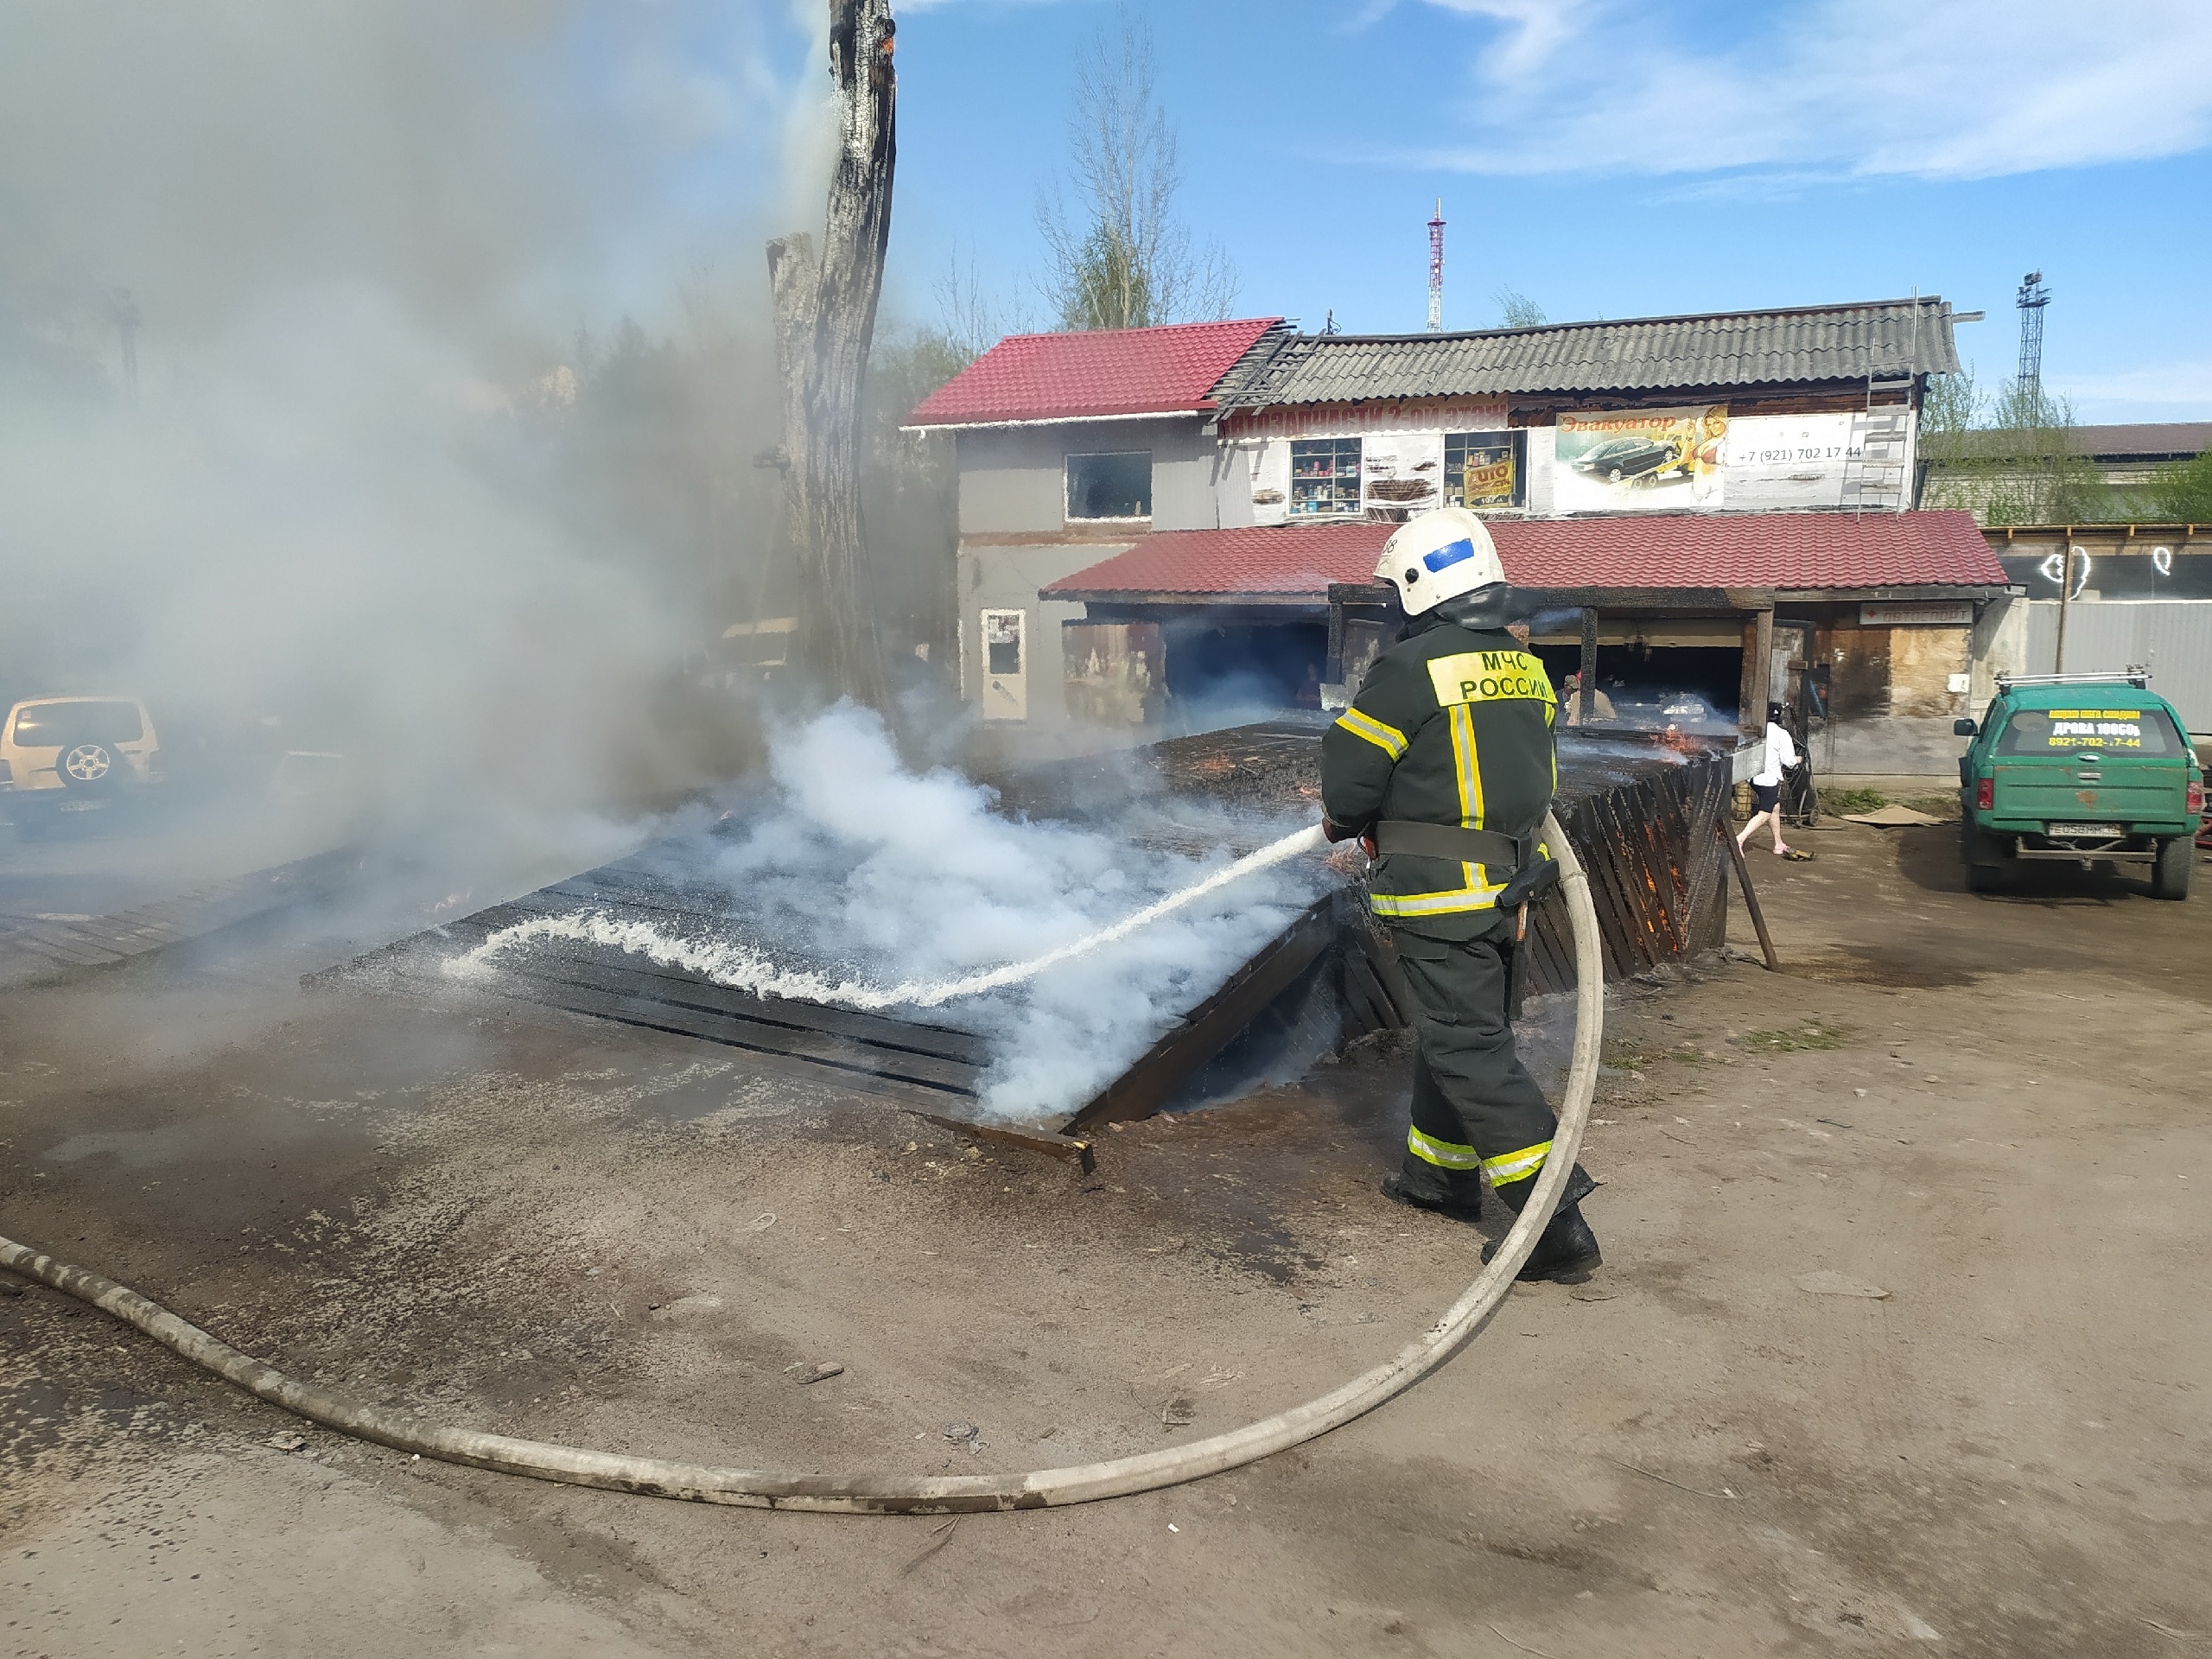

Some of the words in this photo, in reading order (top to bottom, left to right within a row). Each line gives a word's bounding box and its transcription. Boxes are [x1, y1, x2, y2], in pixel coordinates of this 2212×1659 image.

[1560, 416, 1676, 435] Эвакуатор
[1739, 451, 1756, 462] +7
[1760, 448, 1793, 463] (921)
[1798, 448, 1821, 460] 702
[1826, 447, 1841, 458] 17
[1845, 446, 1862, 458] 44
[1481, 652, 1529, 671] МЧС
[1459, 677, 1548, 700] РОССИИ
[2052, 721, 2095, 736] ДРОВА
